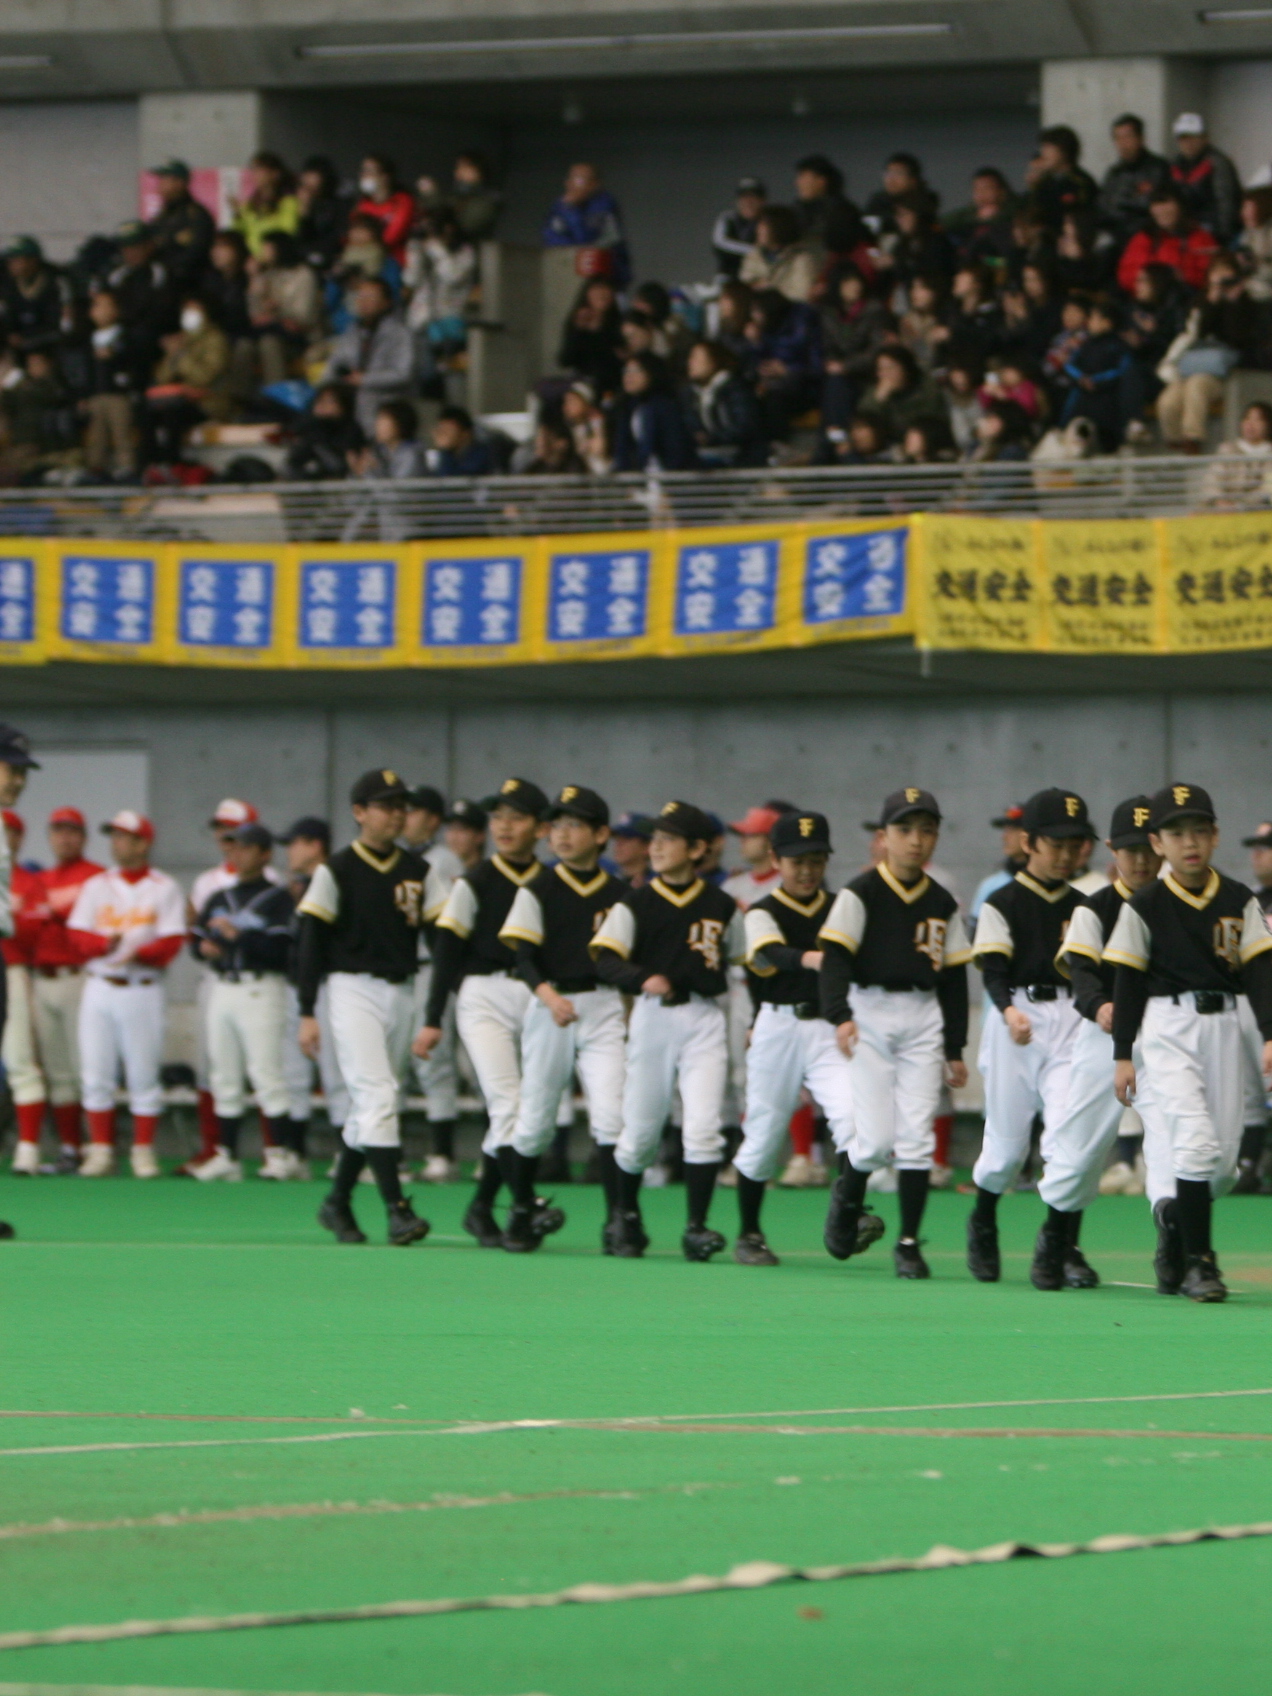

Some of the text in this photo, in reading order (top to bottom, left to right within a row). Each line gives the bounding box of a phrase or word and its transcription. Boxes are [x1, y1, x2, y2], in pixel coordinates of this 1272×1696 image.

[935, 569, 1032, 601] 交通安全
[1053, 573, 1153, 606] 交通安全
